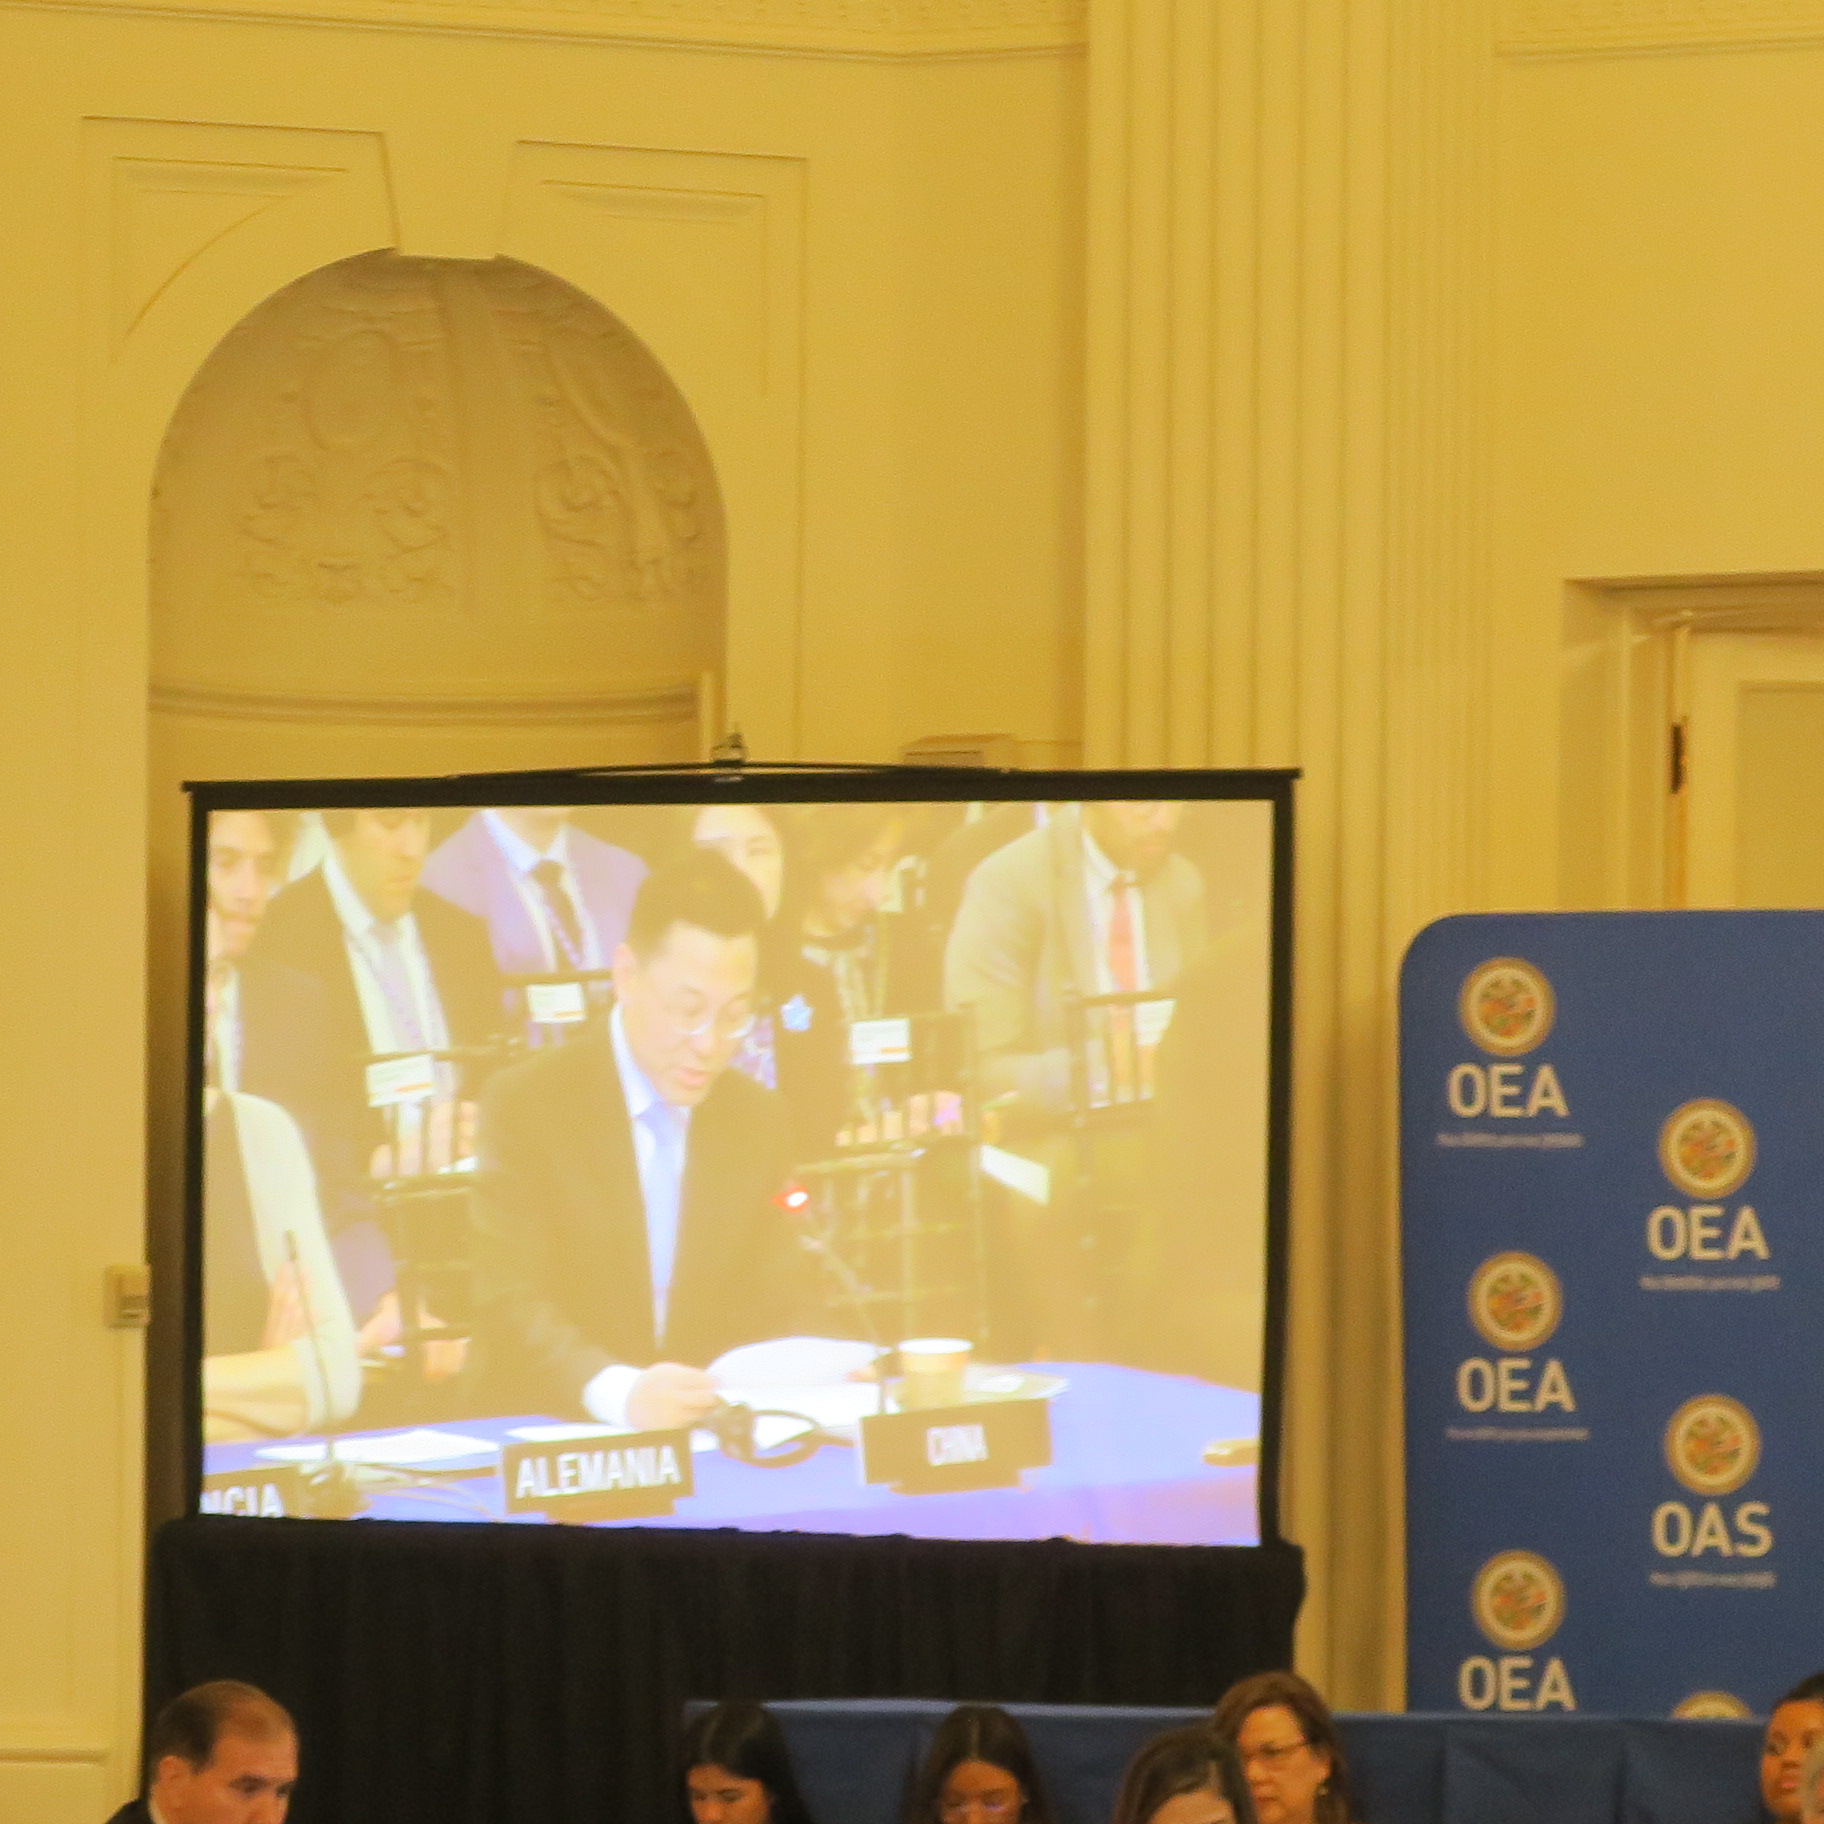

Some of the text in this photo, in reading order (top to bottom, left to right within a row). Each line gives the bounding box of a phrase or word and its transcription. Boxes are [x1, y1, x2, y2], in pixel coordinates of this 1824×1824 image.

[1448, 1064, 1568, 1118] OEA
[1647, 1205, 1770, 1260] OEA
[1457, 1358, 1575, 1413] OEA
[515, 1444, 682, 1499] ALEMANIA
[1652, 1502, 1773, 1557] OAS
[1458, 1657, 1576, 1711] OEA
